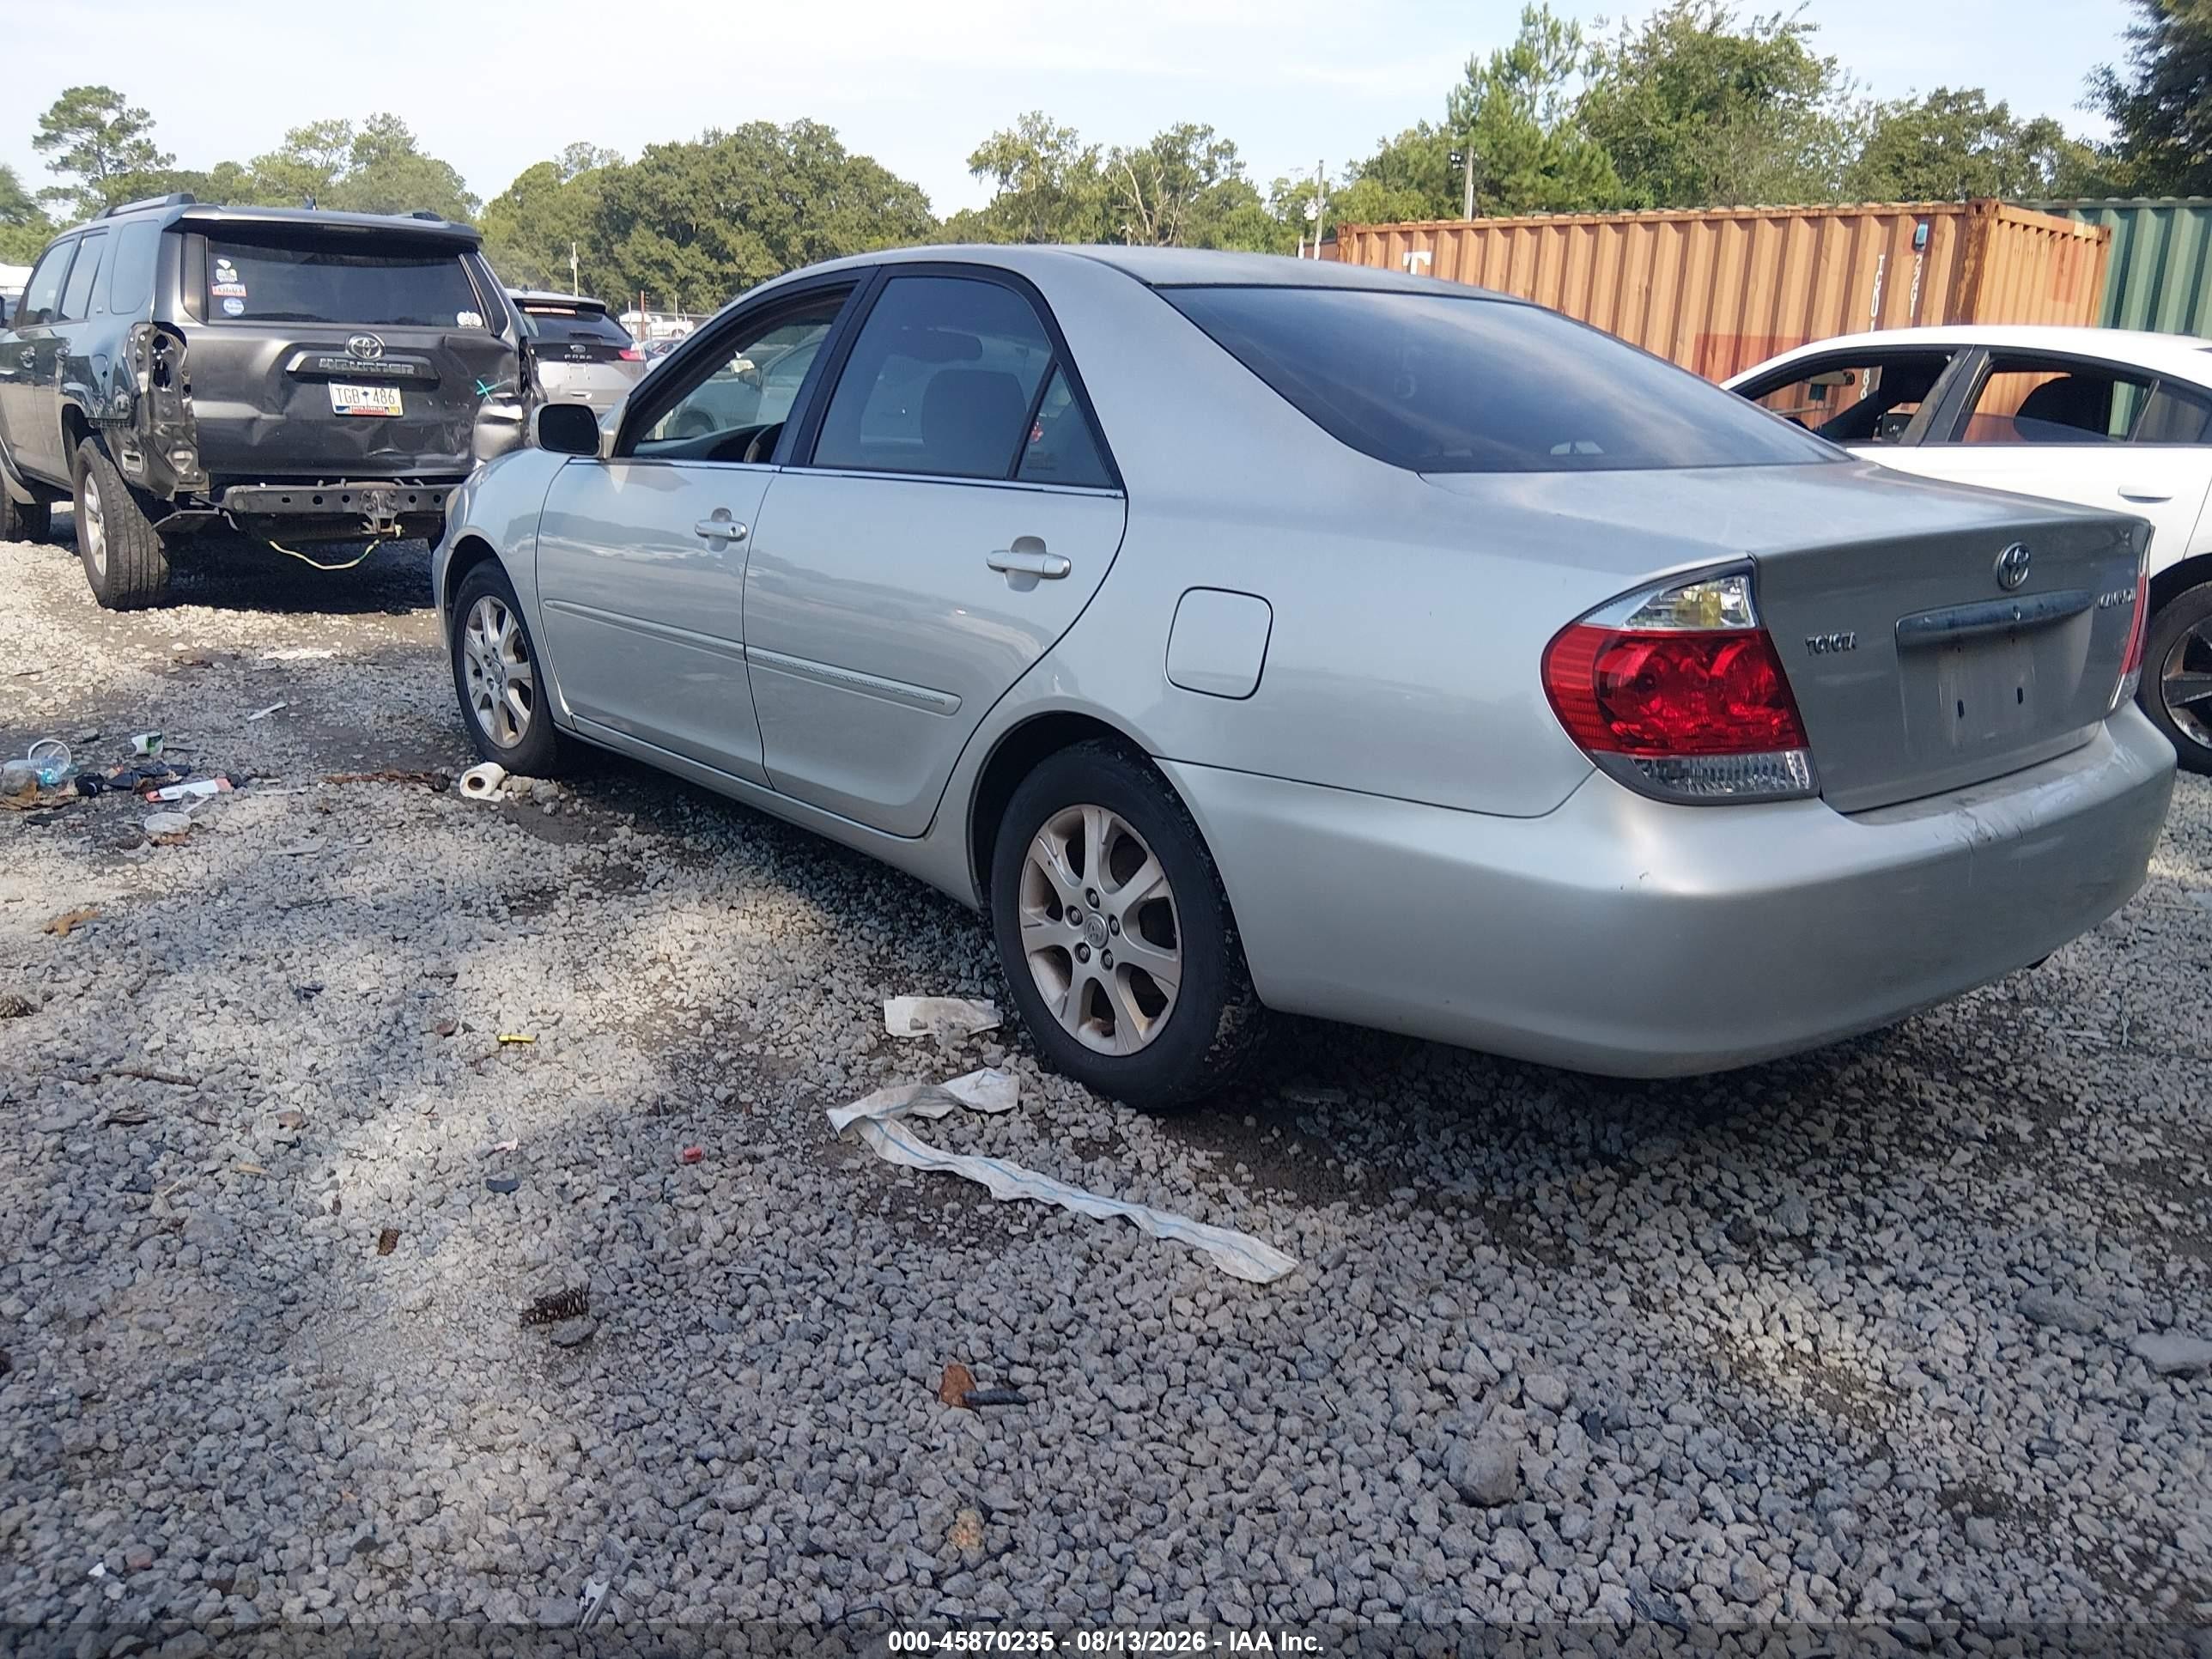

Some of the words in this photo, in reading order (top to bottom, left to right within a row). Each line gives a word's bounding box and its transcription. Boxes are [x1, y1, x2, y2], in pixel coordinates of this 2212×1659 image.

[336, 387, 360, 404] TGB
[373, 388, 396, 405] 486
[1805, 631, 1856, 656] TOYOTA
